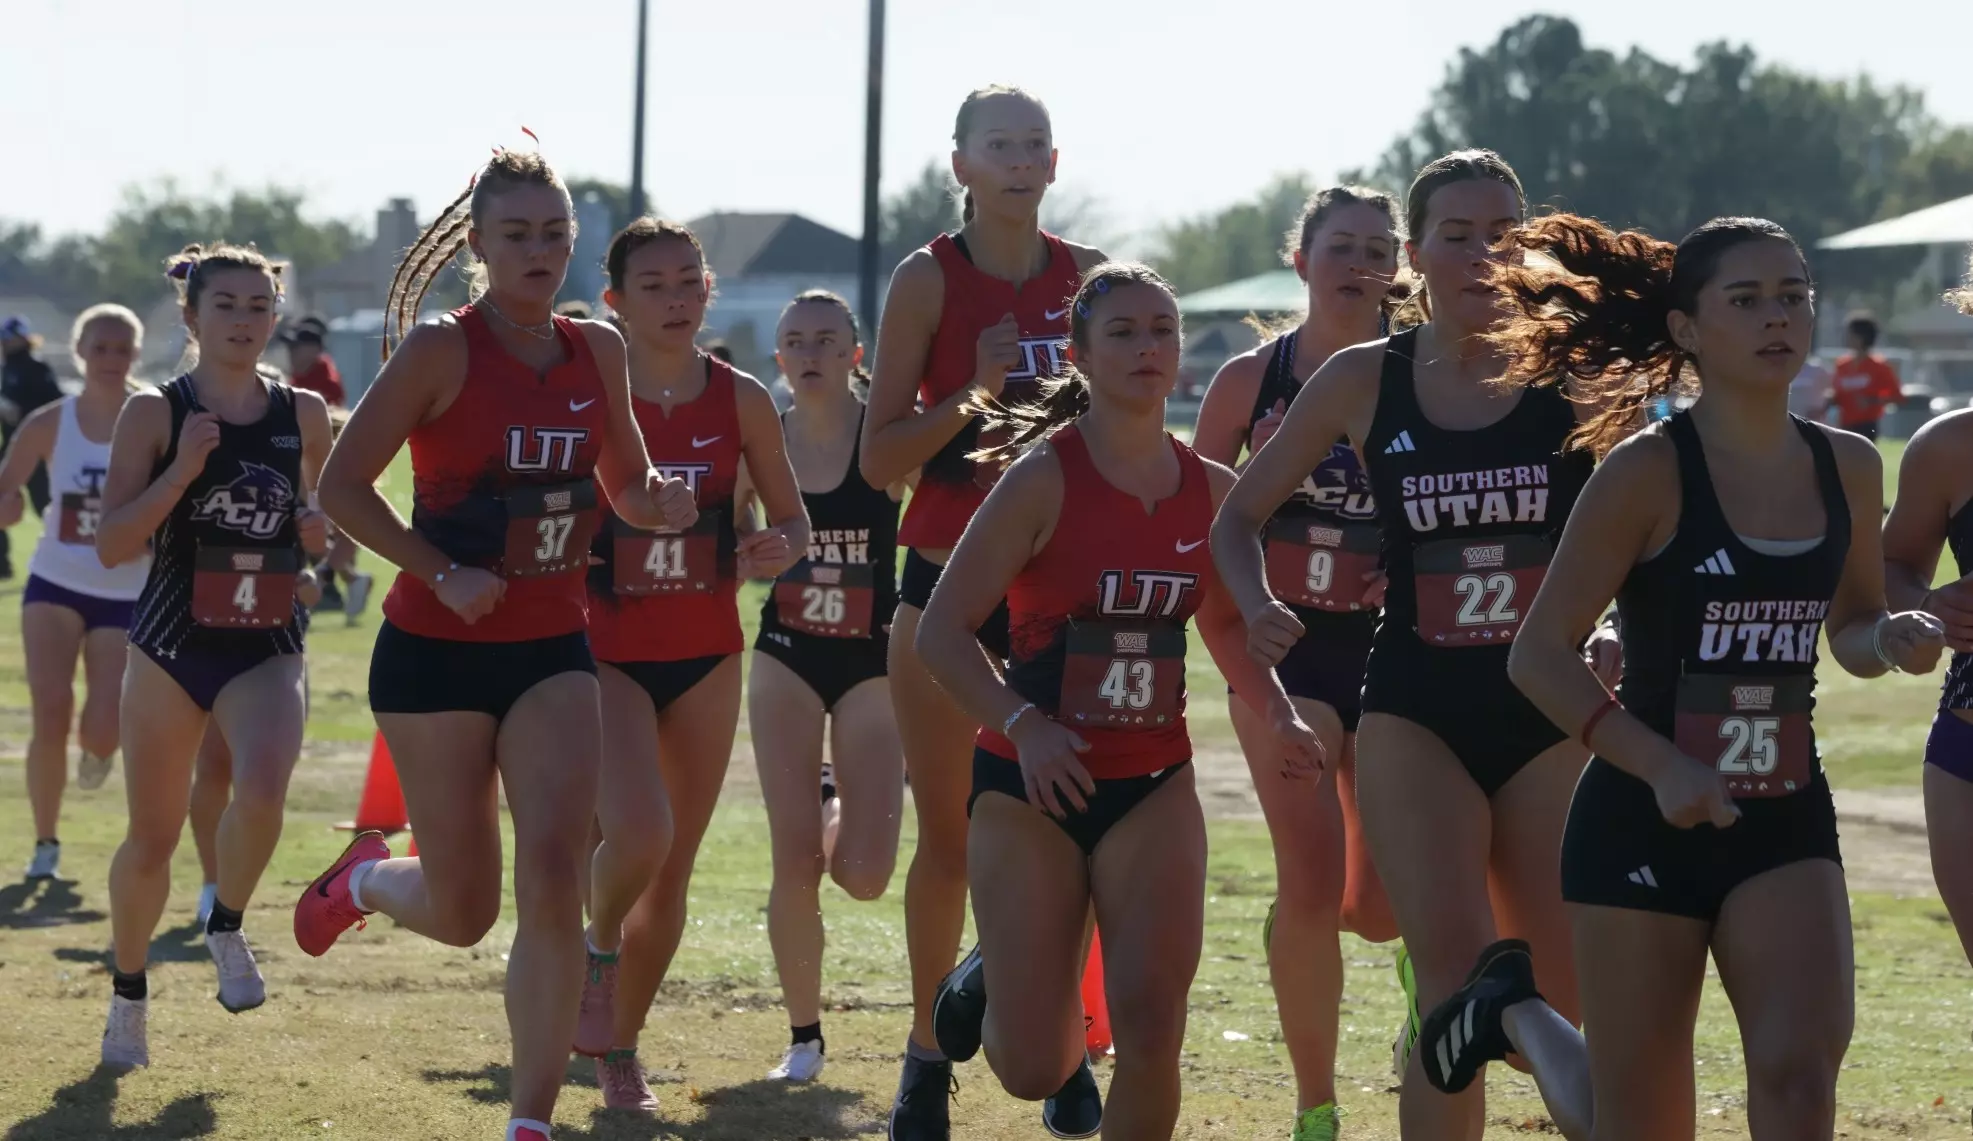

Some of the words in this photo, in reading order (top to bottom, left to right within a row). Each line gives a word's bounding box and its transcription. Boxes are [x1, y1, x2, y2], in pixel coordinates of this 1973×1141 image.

[504, 425, 590, 473] UT
[1402, 465, 1548, 497] SOUTHERN
[196, 488, 287, 536] ACU
[1403, 488, 1549, 532] UTAH
[535, 514, 577, 562] 37
[806, 543, 869, 564] TAH
[809, 528, 869, 544] THERN
[1308, 526, 1343, 544] WAC
[1463, 545, 1504, 563] WAC
[644, 537, 688, 580] 41
[1305, 550, 1335, 593] 9
[232, 573, 259, 614] 4
[801, 587, 845, 625] 26
[1096, 570, 1199, 619] UT
[1454, 571, 1519, 627] 22
[1705, 600, 1829, 622] SOUTHERN
[1114, 632, 1148, 648] WAC
[1699, 623, 1818, 663] UTAH
[1098, 659, 1155, 711] 43
[1732, 686, 1774, 704] WAC
[1717, 716, 1780, 776] 25
